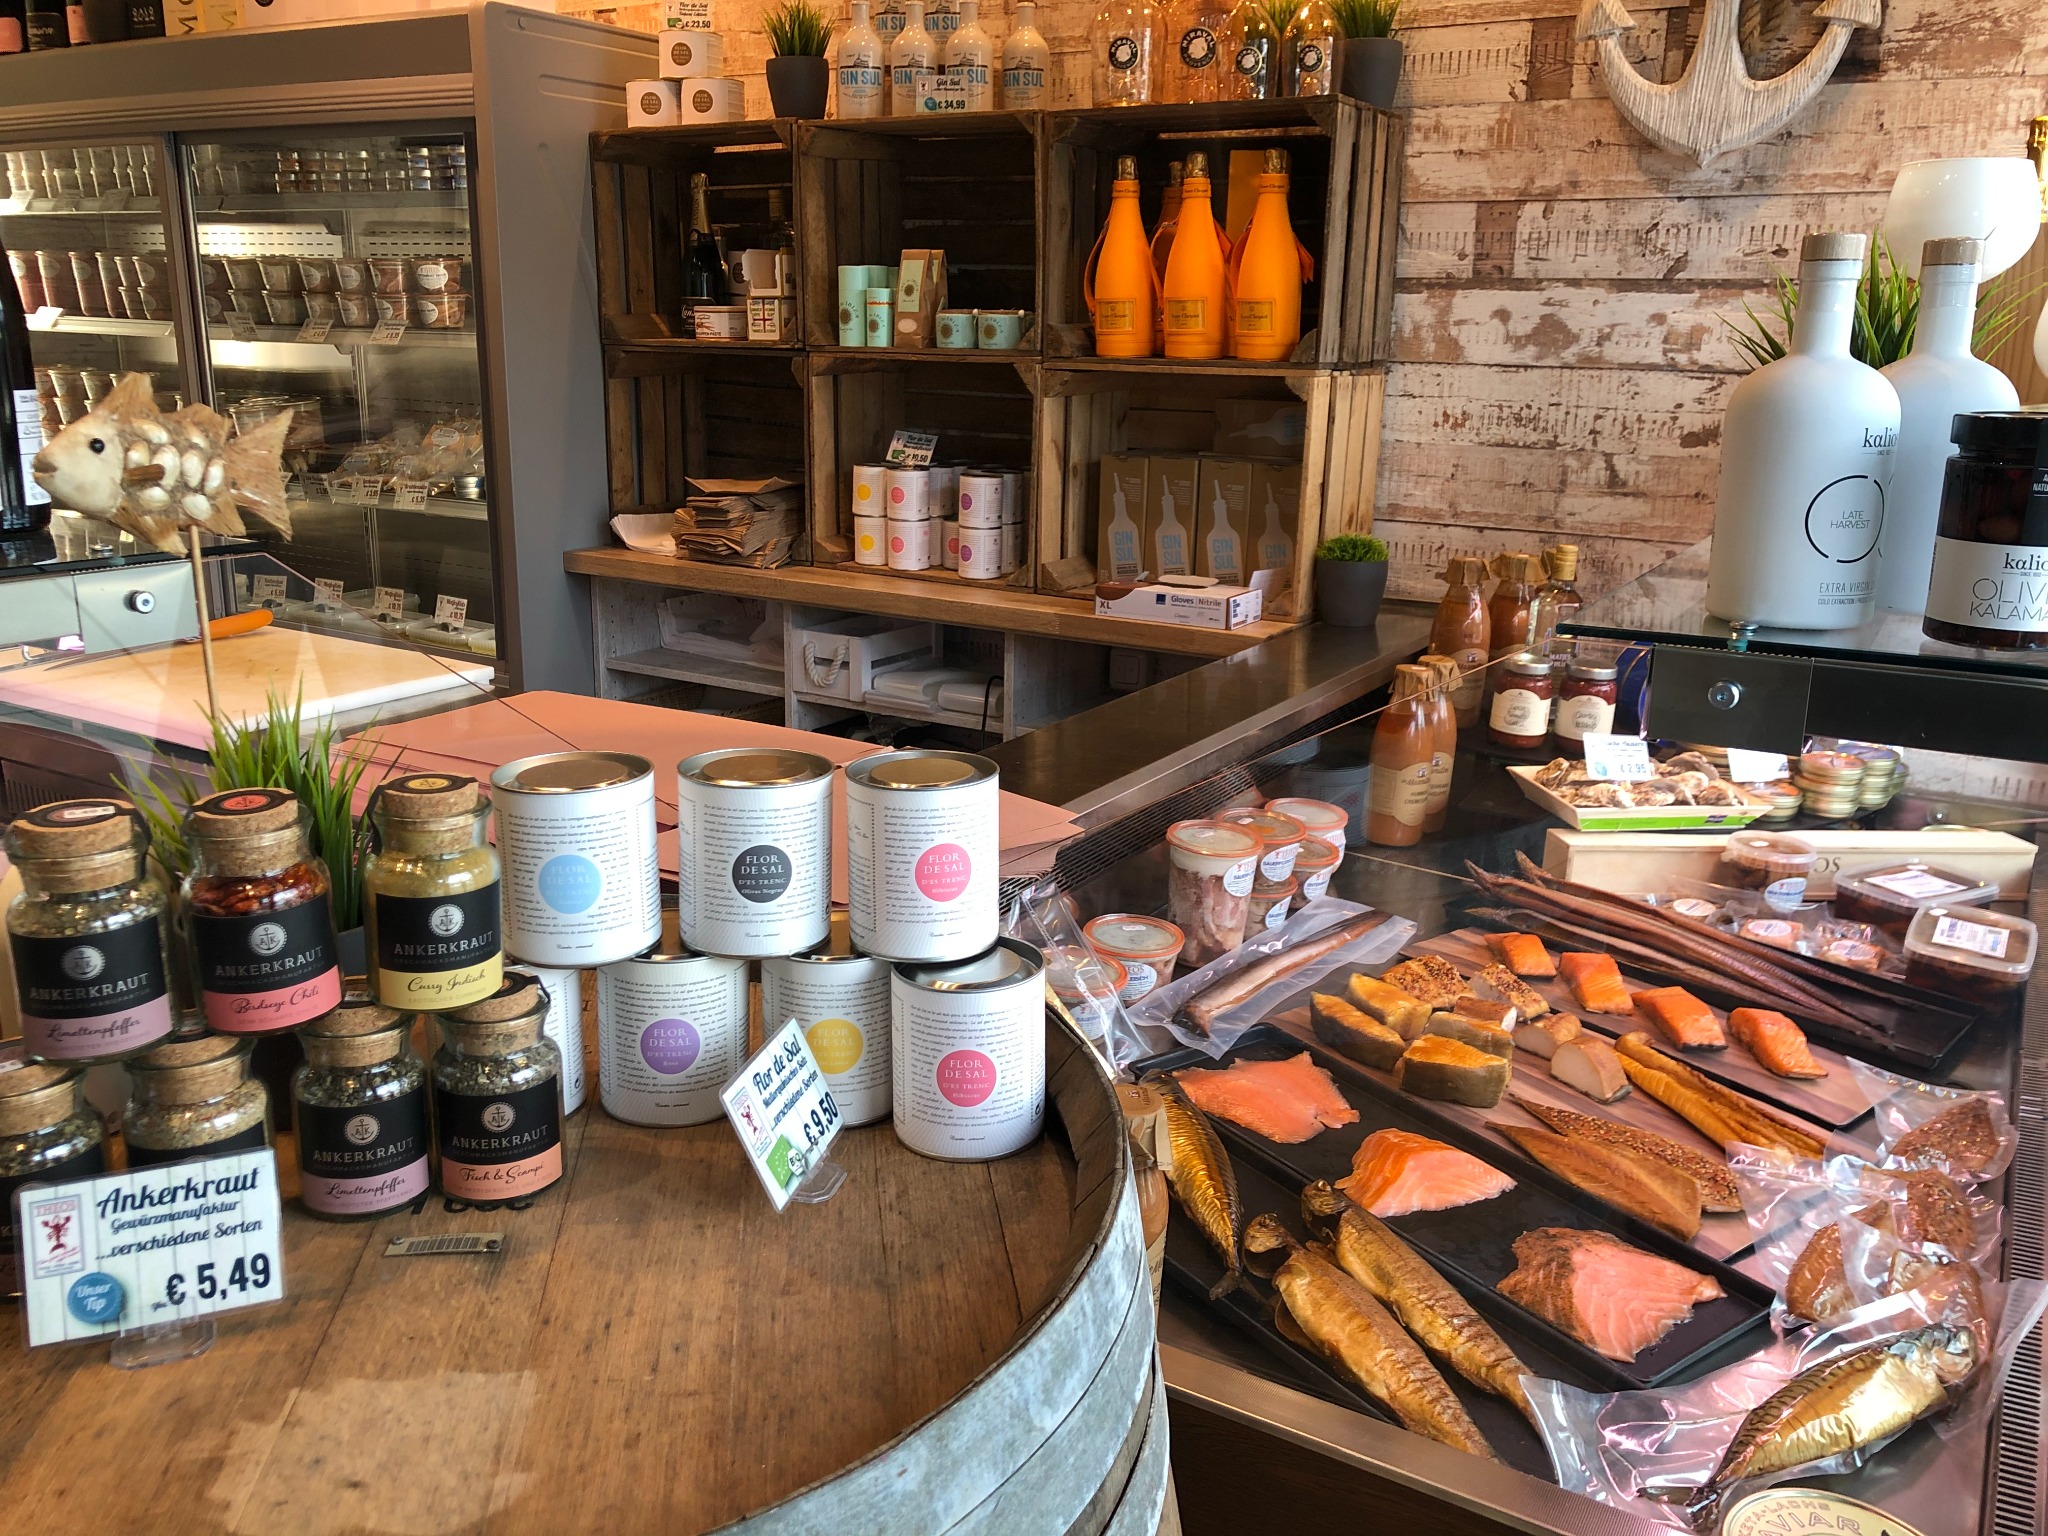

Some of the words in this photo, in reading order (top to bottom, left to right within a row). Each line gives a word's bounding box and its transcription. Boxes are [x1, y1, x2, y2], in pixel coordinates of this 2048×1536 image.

[691, 20, 711, 28] 23,50
[876, 16, 888, 30] IN
[1181, 28, 1216, 49] MIRAVAL
[840, 71, 859, 85] GIN
[861, 71, 882, 86] SUL
[894, 70, 912, 84] GIN
[936, 78, 947, 87] Gin
[949, 78, 961, 86] Sul
[968, 69, 988, 84] SUL
[1003, 71, 1023, 86] GIN
[1025, 72, 1044, 87] SUL
[938, 101, 943, 109] €
[944, 100, 965, 110] 34,99
[1842, 510, 1865, 520] LATE
[1830, 520, 1870, 529] HARVEST
[1114, 531, 1133, 546] GIN
[1161, 534, 1181, 549] GIN
[1212, 538, 1233, 553] GIN
[1116, 547, 1135, 562] SUL
[1163, 551, 1184, 566] SUL
[1265, 544, 1286, 559] GIN
[1214, 555, 1236, 570] SUL
[1819, 582, 1846, 593] EXTRA
[1973, 578, 2048, 604] OLIV
[1099, 600, 1112, 610] XL
[1171, 595, 1195, 605] Gloves
[1198, 596, 1222, 608] Nitrile
[746, 855, 780, 864] FLOR
[929, 852, 960, 863] FLOR
[552, 865, 586, 874] FLOR
[741, 866, 759, 875] DE
[762, 864, 785, 875] SAL
[924, 865, 940, 874] DE
[944, 863, 965, 874] SAL
[547, 876, 564, 885] DE
[568, 875, 593, 885] SAL
[759, 878, 787, 886] TRENC
[940, 876, 967, 885] TRENC
[394, 930, 494, 956] ANKERKRAUT
[214, 946, 324, 977] ANKERKRAUT
[29, 972, 149, 1001] ANKERKRAUT
[407, 976, 443, 994] Curry
[446, 969, 486, 991] Indisch
[231, 997, 287, 1016] Birdseye
[289, 986, 320, 1006] Chili
[47, 1017, 141, 1042] Limettenpfeffer
[654, 1028, 687, 1037] FLOR
[818, 1028, 849, 1036] FLOR
[649, 1038, 666, 1047] DE
[669, 1038, 692, 1047] SAL
[813, 1038, 829, 1046] DE
[833, 1038, 854, 1046] SAL
[753, 1068, 774, 1096] Flor
[773, 1054, 787, 1076] de
[783, 1033, 802, 1063] Sal
[950, 1060, 983, 1068] FLOR
[802, 1069, 819, 1091] Sorten
[945, 1070, 962, 1079] DE
[965, 1069, 988, 1078] SAL
[804, 1123, 816, 1146] €
[811, 1091, 838, 1137] 9,50
[452, 1125, 548, 1150] ANKERKRAUT
[313, 1137, 415, 1164] ANKERKRAUT
[460, 1166, 491, 1183] Fisch
[493, 1167, 504, 1181] &
[505, 1161, 545, 1184] Scampi
[96, 1167, 261, 1219] Ankerkraut
[326, 1177, 406, 1200] Limettenpfeffer
[34, 1200, 78, 1217] THEOS
[111, 1201, 242, 1235] Gewürzmanufaktur
[214, 1221, 262, 1238] Sorten
[166, 1273, 187, 1306] €
[197, 1252, 271, 1300] 5,49
[76, 1283, 111, 1297] Unser
[83, 1296, 107, 1312] Tip
